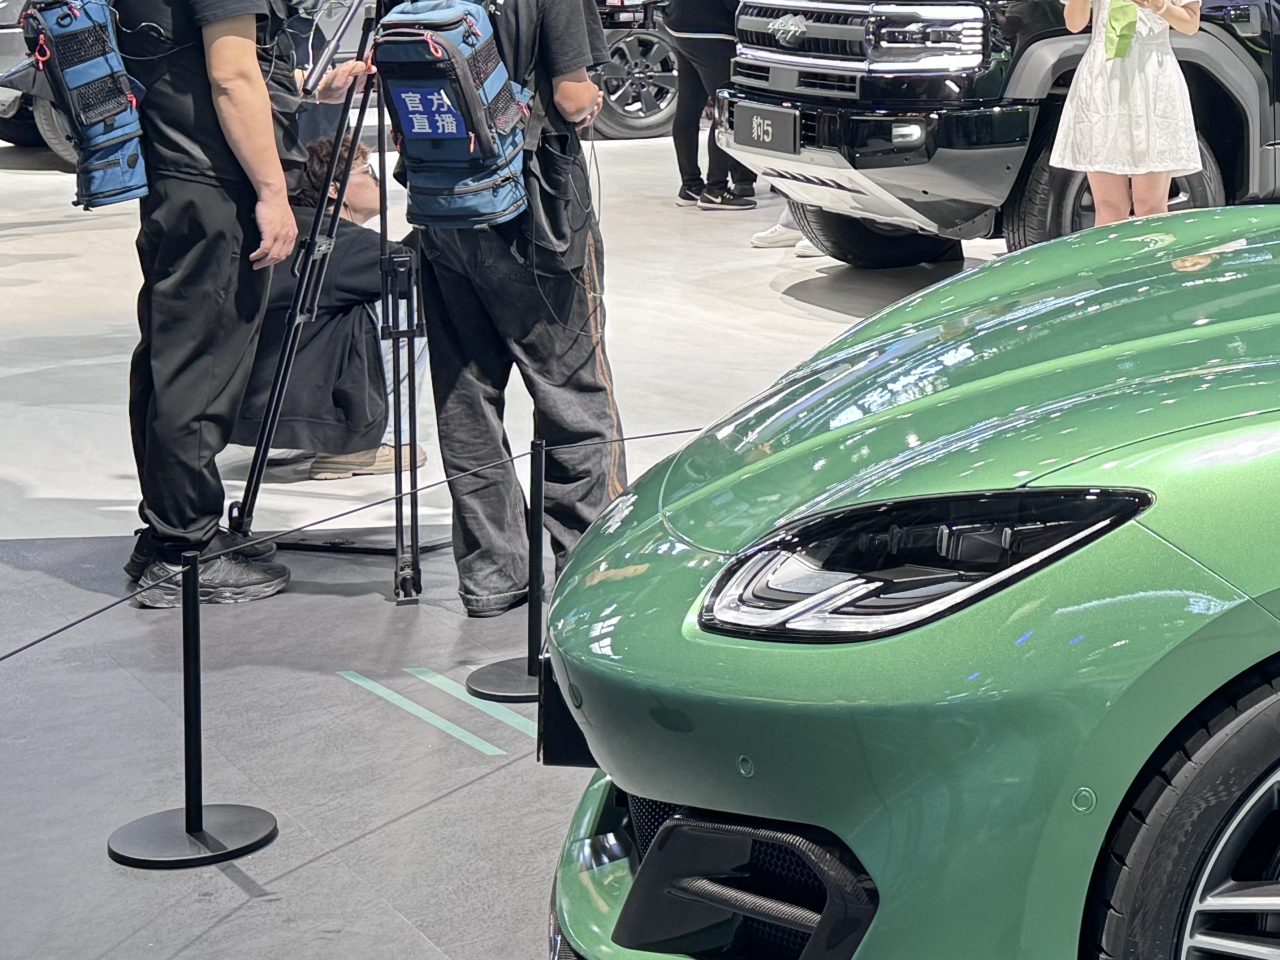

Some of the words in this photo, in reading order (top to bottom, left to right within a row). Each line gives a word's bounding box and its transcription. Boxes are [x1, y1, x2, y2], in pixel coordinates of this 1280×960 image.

[400, 92, 449, 112] 官方
[408, 113, 457, 134] 直播
[751, 114, 773, 143] 豹5
